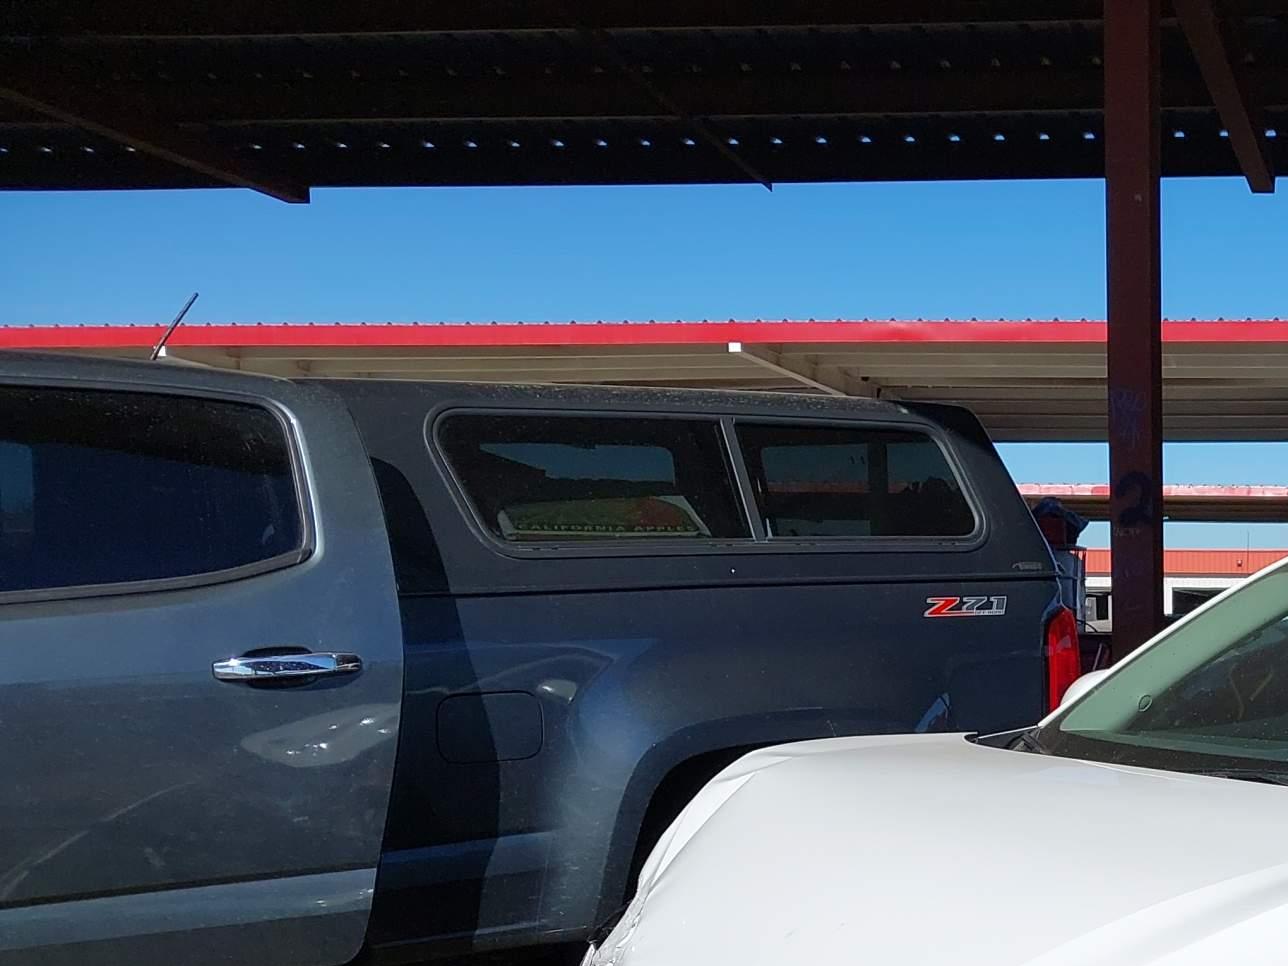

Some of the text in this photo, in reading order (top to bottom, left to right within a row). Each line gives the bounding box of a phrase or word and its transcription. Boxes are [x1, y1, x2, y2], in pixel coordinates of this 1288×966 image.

[518, 522, 695, 532] CALIFORNIA APPLES
[924, 596, 1007, 617] Z71
